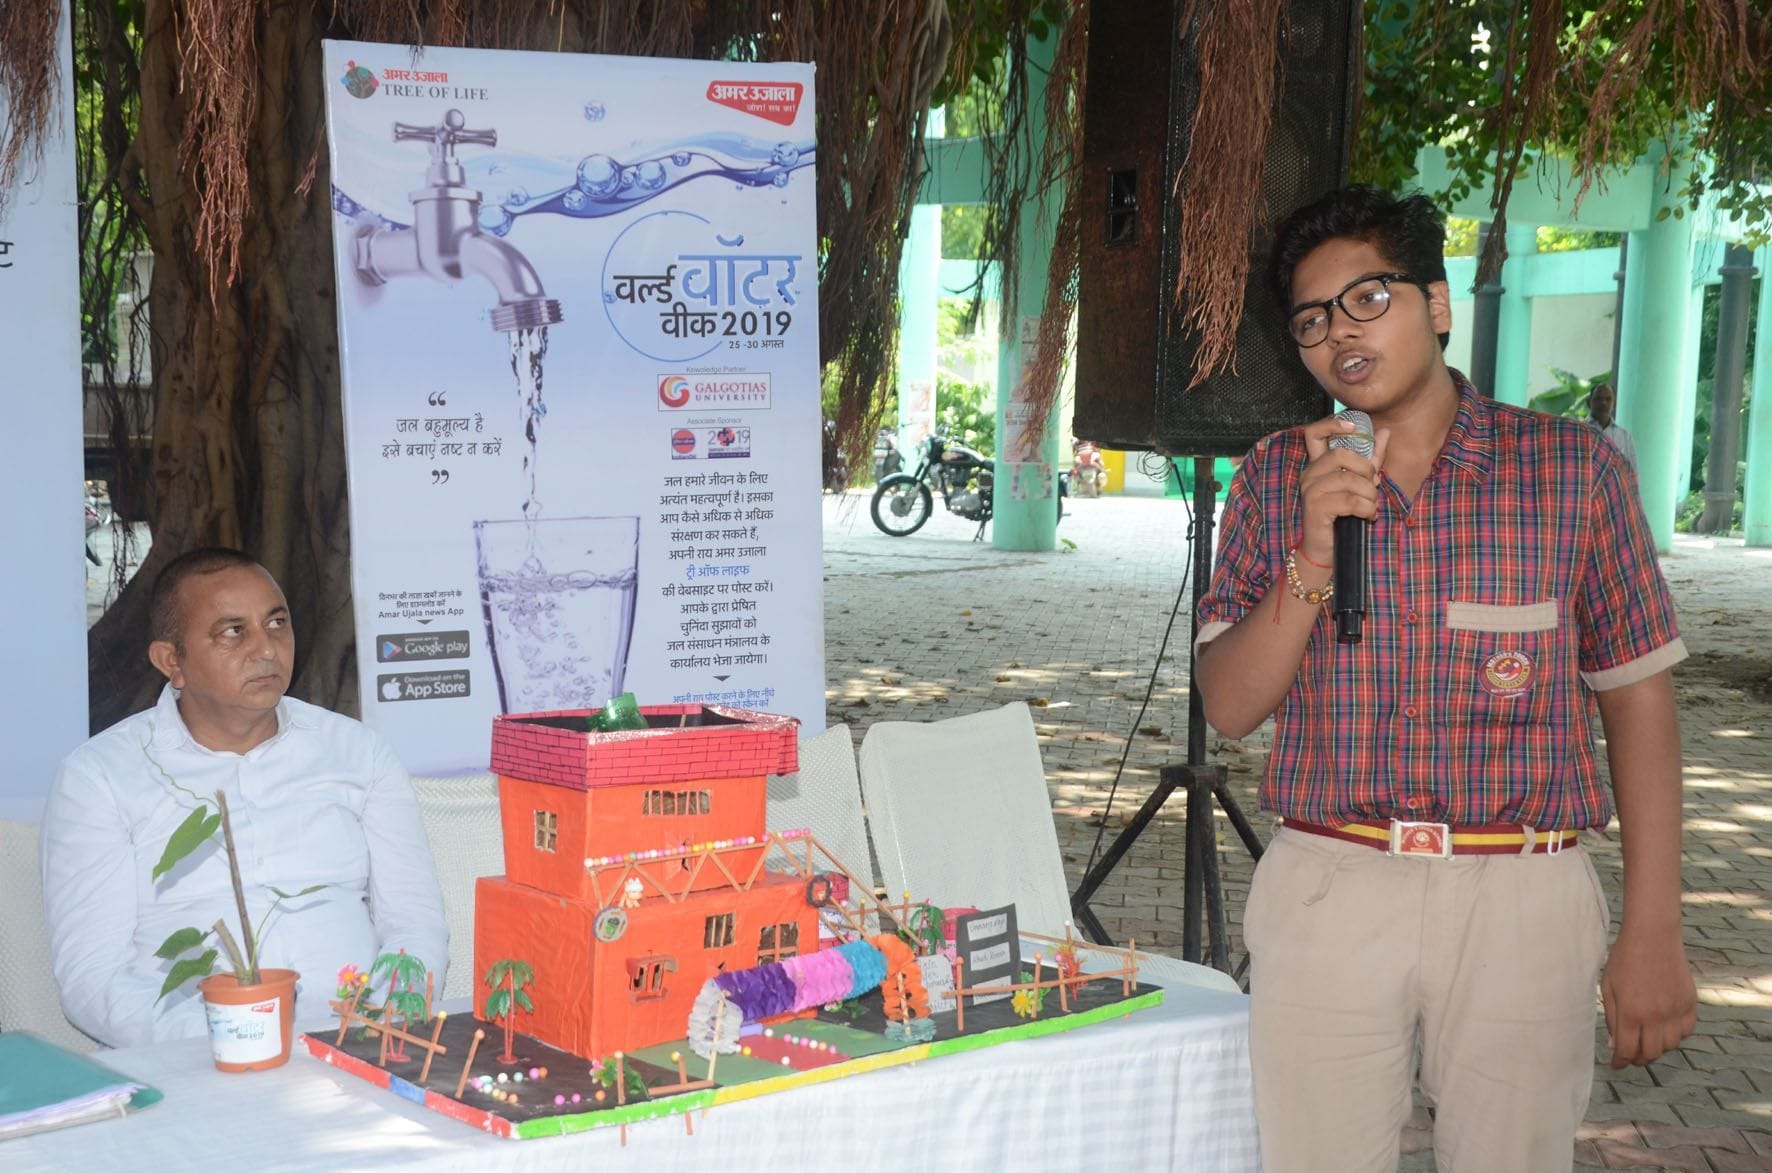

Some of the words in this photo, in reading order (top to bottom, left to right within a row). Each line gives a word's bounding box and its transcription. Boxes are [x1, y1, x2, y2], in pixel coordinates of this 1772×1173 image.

[383, 68, 410, 81] अमर
[412, 70, 448, 83] उजाला
[383, 84, 424, 98] TREE
[429, 86, 450, 98] OF
[454, 87, 488, 100] LIFE
[712, 84, 748, 100] अमर
[749, 86, 796, 102] उजाला
[613, 264, 677, 304] वर्ल्ड
[678, 233, 802, 306] वॉटर
[660, 301, 718, 338] वीक
[722, 311, 792, 336] 2019
[728, 340, 740, 350] 25
[761, 340, 784, 349] अगस्त
[695, 382, 766, 393] GALGOTIAS
[696, 394, 766, 402] UNIVERSITY
[396, 418, 420, 432] जल
[424, 418, 470, 438] बहुमूल्य
[474, 412, 484, 432] है
[382, 439, 402, 459] इसे
[406, 439, 436, 460] बचाएं
[440, 443, 463, 456] नष्ट
[467, 443, 478, 455] न
[482, 437, 502, 456] करें
[664, 476, 682, 486] जल
[684, 473, 706, 487] हमारे
[708, 472, 734, 486] जीवन
[736, 472, 746, 484] के
[750, 471, 768, 484] लिए
[660, 492, 688, 506] अत्यंत
[690, 490, 732, 508] महत्वपूर्ण
[734, 490, 744, 504] है।
[746, 492, 774, 504] इसका
[660, 513, 679, 524] आप
[682, 510, 700, 524] कैसे
[702, 509, 732, 522] अधिक
[734, 508, 742, 520] से
[744, 508, 774, 520] अधिक
[670, 528, 702, 542] संरक्षण
[705, 530, 720, 540] कर
[722, 528, 747, 540] सकते
[669, 546, 694, 560] अपनी
[697, 548, 712, 559] राय
[716, 548, 735, 558] अमर
[738, 546, 766, 558] उजाला
[686, 564, 696, 580] ट्री
[698, 564, 720, 577] ऑफ
[722, 565, 750, 576] लाइफ
[662, 583, 675, 597] की
[678, 584, 714, 596] वेबसाइट
[718, 585, 728, 594] पर
[732, 580, 752, 594] पोस्ट
[402, 610, 422, 618] Ujala
[448, 608, 464, 616] App
[680, 601, 708, 614] आपके
[712, 602, 728, 615] द्वारा
[732, 598, 756, 612] प्रेषित
[680, 618, 708, 636] चुनिंदा
[712, 617, 741, 634] सुझावों
[744, 616, 756, 629] को
[404, 641, 444, 656] Google
[446, 640, 468, 654] play
[666, 640, 684, 651] जल
[687, 636, 722, 650] संसाधन
[724, 634, 758, 648] मंत्रालय
[760, 633, 770, 646] के
[670, 654, 710, 670] कार्यालय
[712, 654, 732, 666] भेजा
[734, 652, 768, 664] जायेगा।
[404, 674, 442, 683] Download
[405, 683, 432, 698] App
[434, 682, 466, 694] Store
